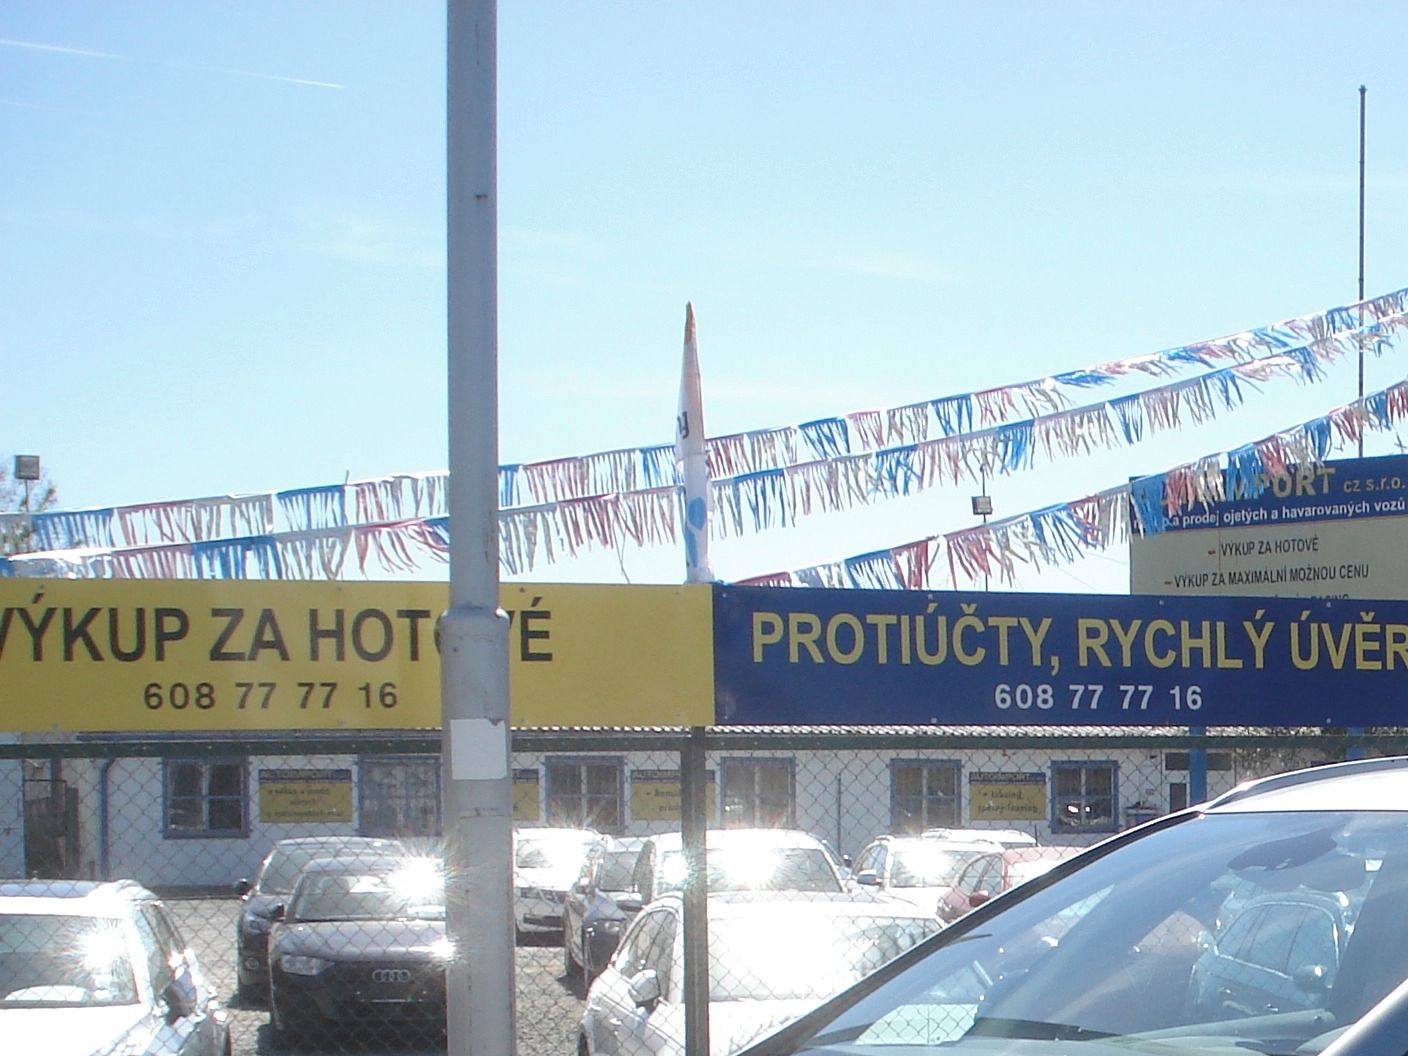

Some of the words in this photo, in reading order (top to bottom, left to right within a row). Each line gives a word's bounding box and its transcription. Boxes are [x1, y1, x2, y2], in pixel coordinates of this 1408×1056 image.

[1344, 480, 1360, 493] cz
[1366, 477, 1406, 491] s.r.o.
[1183, 510, 1219, 527] prodej
[1224, 507, 1267, 525] ojetých
[1271, 509, 1279, 520] a
[1282, 501, 1370, 519] havarovaných
[1221, 540, 1255, 557] VÝKUP
[1258, 541, 1273, 556] ZA
[1275, 537, 1319, 554] HOTOVÉ
[1174, 572, 1209, 588] VÝKUP
[1211, 571, 1226, 587] ZA
[1229, 565, 1287, 586] MAXIMÁLNÍ
[1290, 563, 1337, 583] MOŽNOU
[1339, 564, 1369, 580] CENU
[209, 608, 290, 662] ZA
[308, 596, 553, 663] HOTÉ
[752, 603, 1060, 677] PROTIÚČTY,
[1078, 609, 1276, 669] RYCHLÝ
[144, 682, 216, 710] 608
[235, 682, 278, 710] 77
[297, 682, 338, 709] 77
[358, 682, 398, 709] 16
[994, 683, 1055, 710] 608
[1069, 684, 1104, 710] 77
[1119, 685, 1154, 710] 77
[1170, 685, 1203, 710] 16
